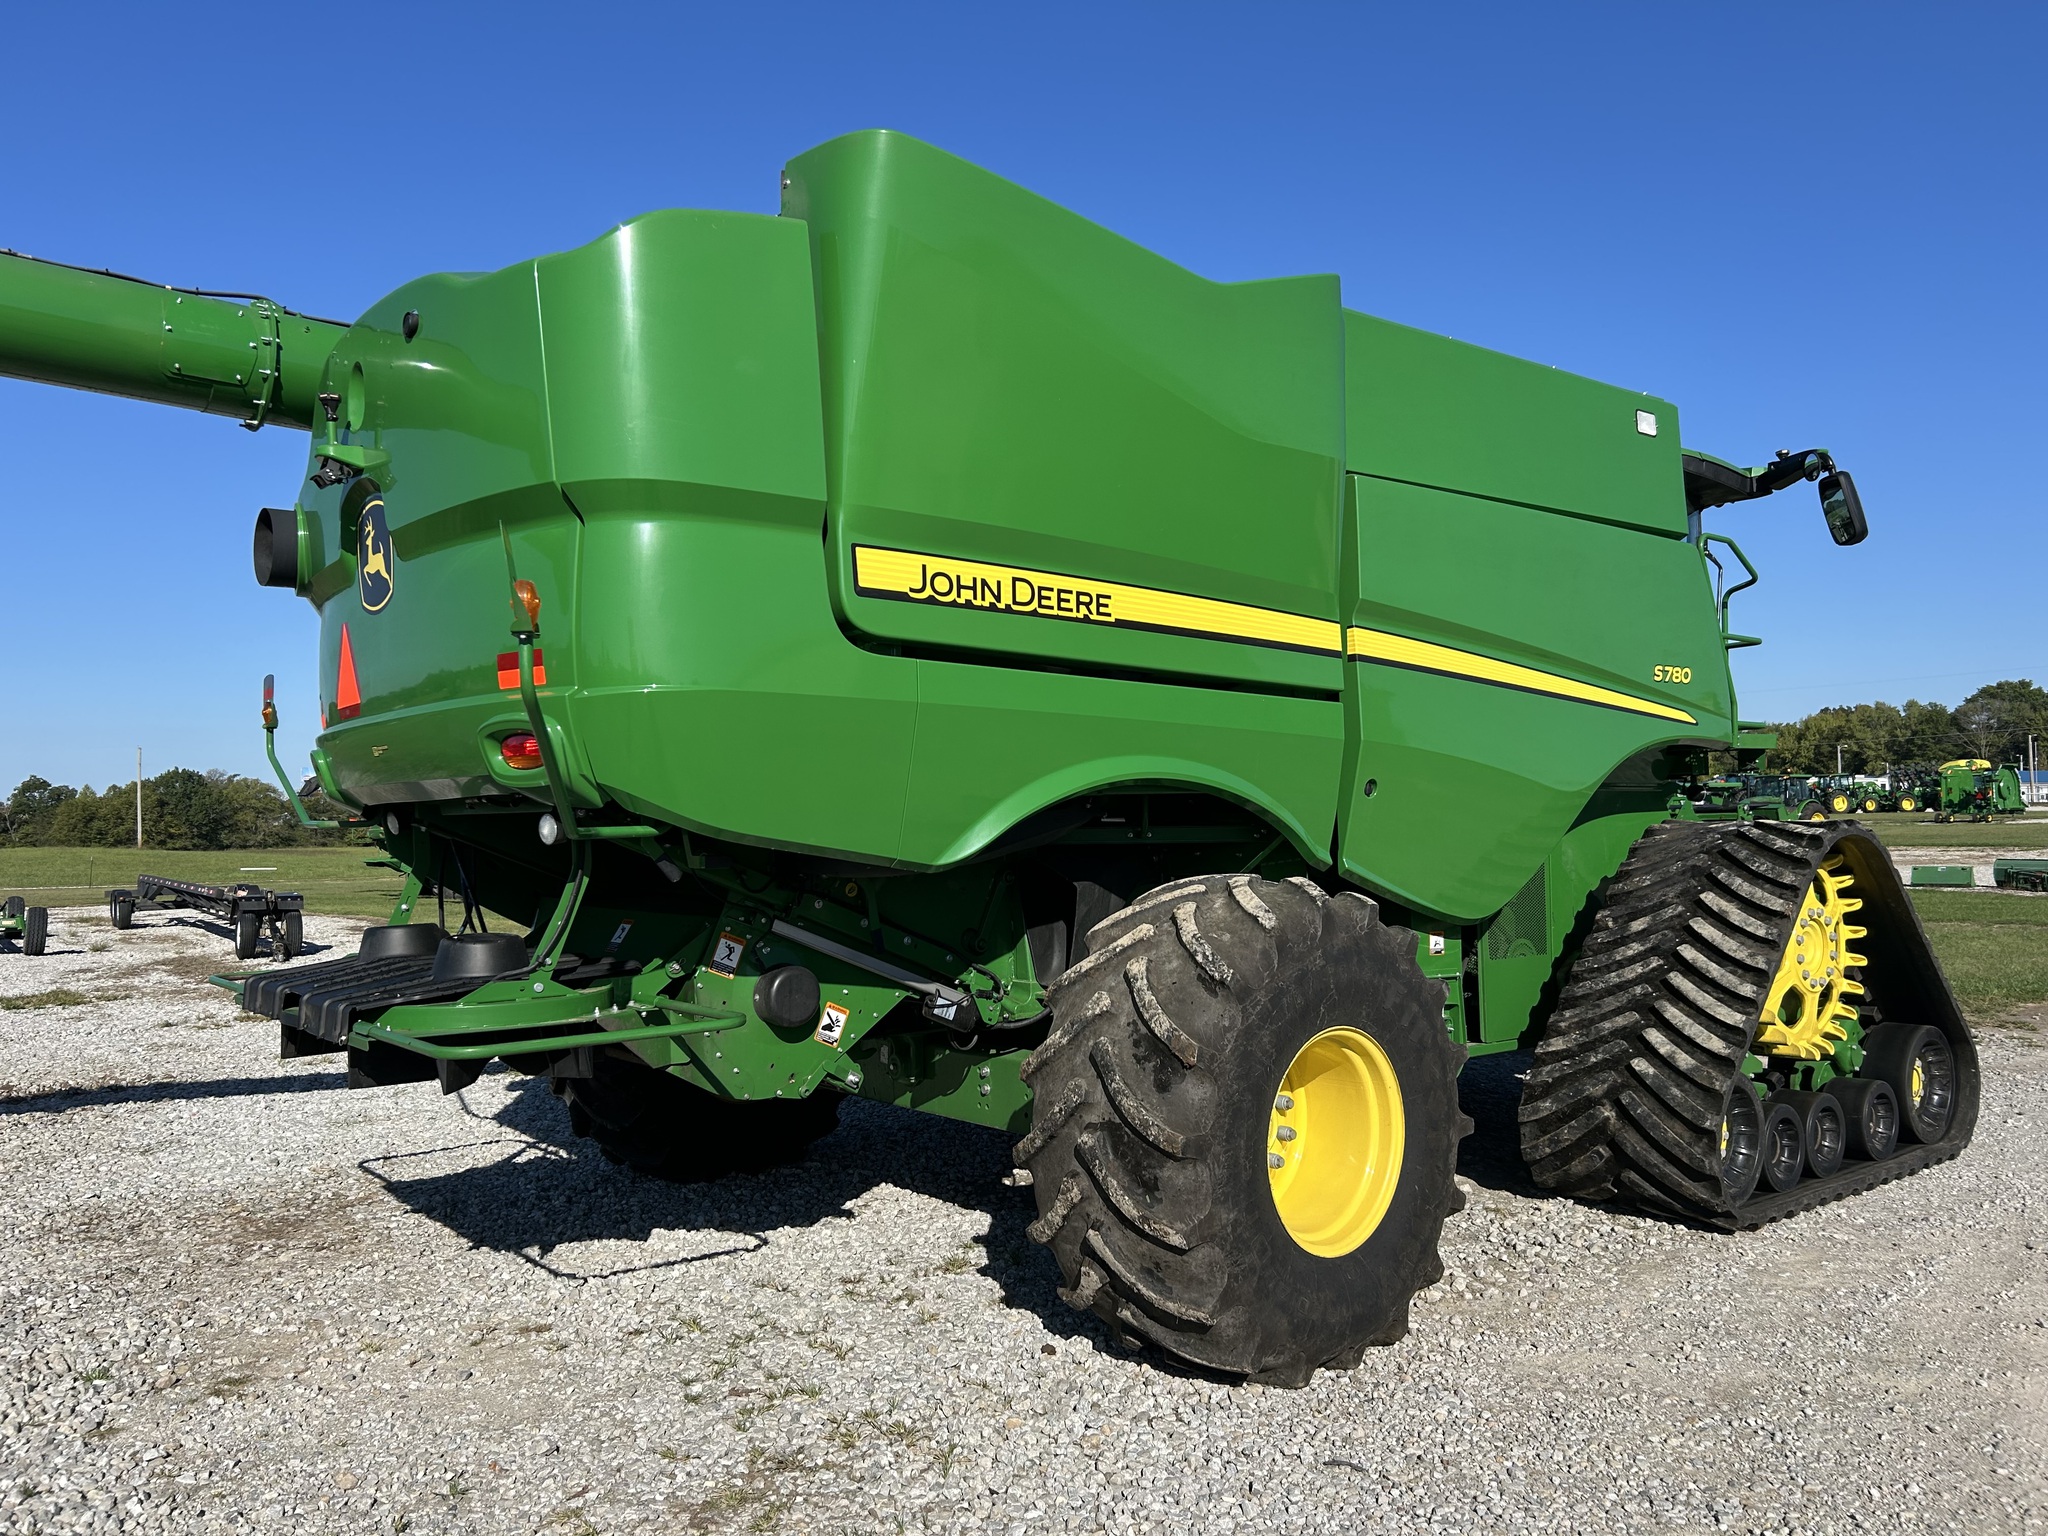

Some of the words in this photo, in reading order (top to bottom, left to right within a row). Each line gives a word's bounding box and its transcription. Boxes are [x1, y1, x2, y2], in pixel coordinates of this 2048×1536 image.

[909, 564, 1002, 604] JOHN
[1011, 576, 1112, 618] DEERE
[1653, 664, 1691, 684] S780
